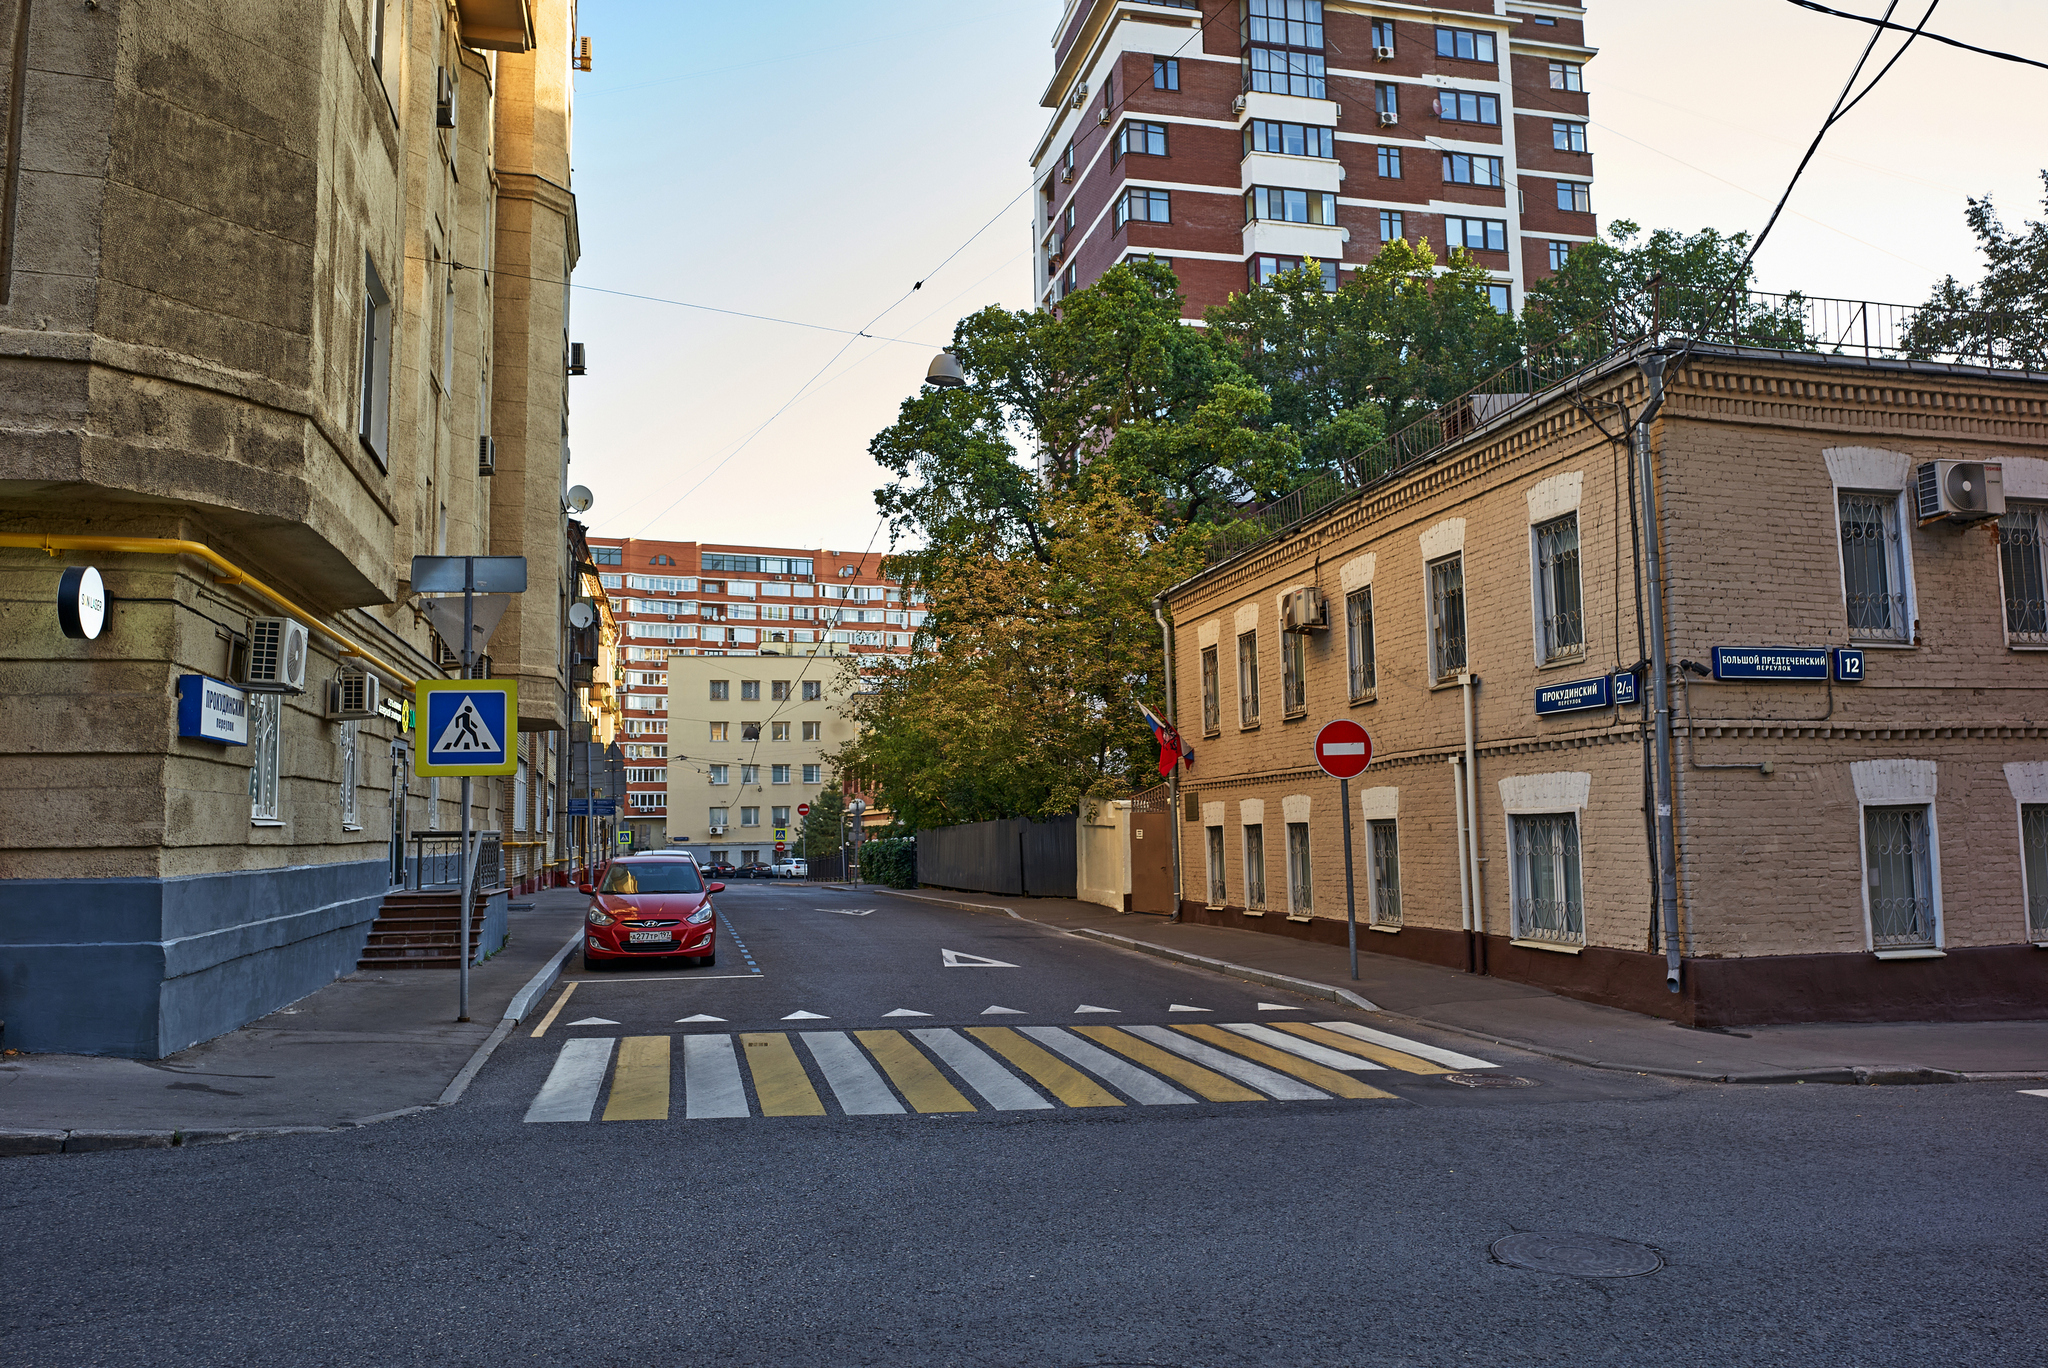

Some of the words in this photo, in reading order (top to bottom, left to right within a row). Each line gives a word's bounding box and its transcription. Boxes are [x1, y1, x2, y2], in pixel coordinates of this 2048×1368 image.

[1722, 655, 1760, 665] БОЛЬШОЙ
[1761, 656, 1826, 666] ПРЕДТЕЧЕНСКИЙ
[1844, 657, 1860, 673] 12
[1542, 682, 1598, 702] ПРОКУДИНСКИЙ
[1616, 681, 1632, 695] 2/12
[205, 689, 245, 717] ПРОКУДИНСКИЙ
[1558, 698, 1582, 706] ПЕРЕУЛОК
[215, 717, 235, 732] переулок
